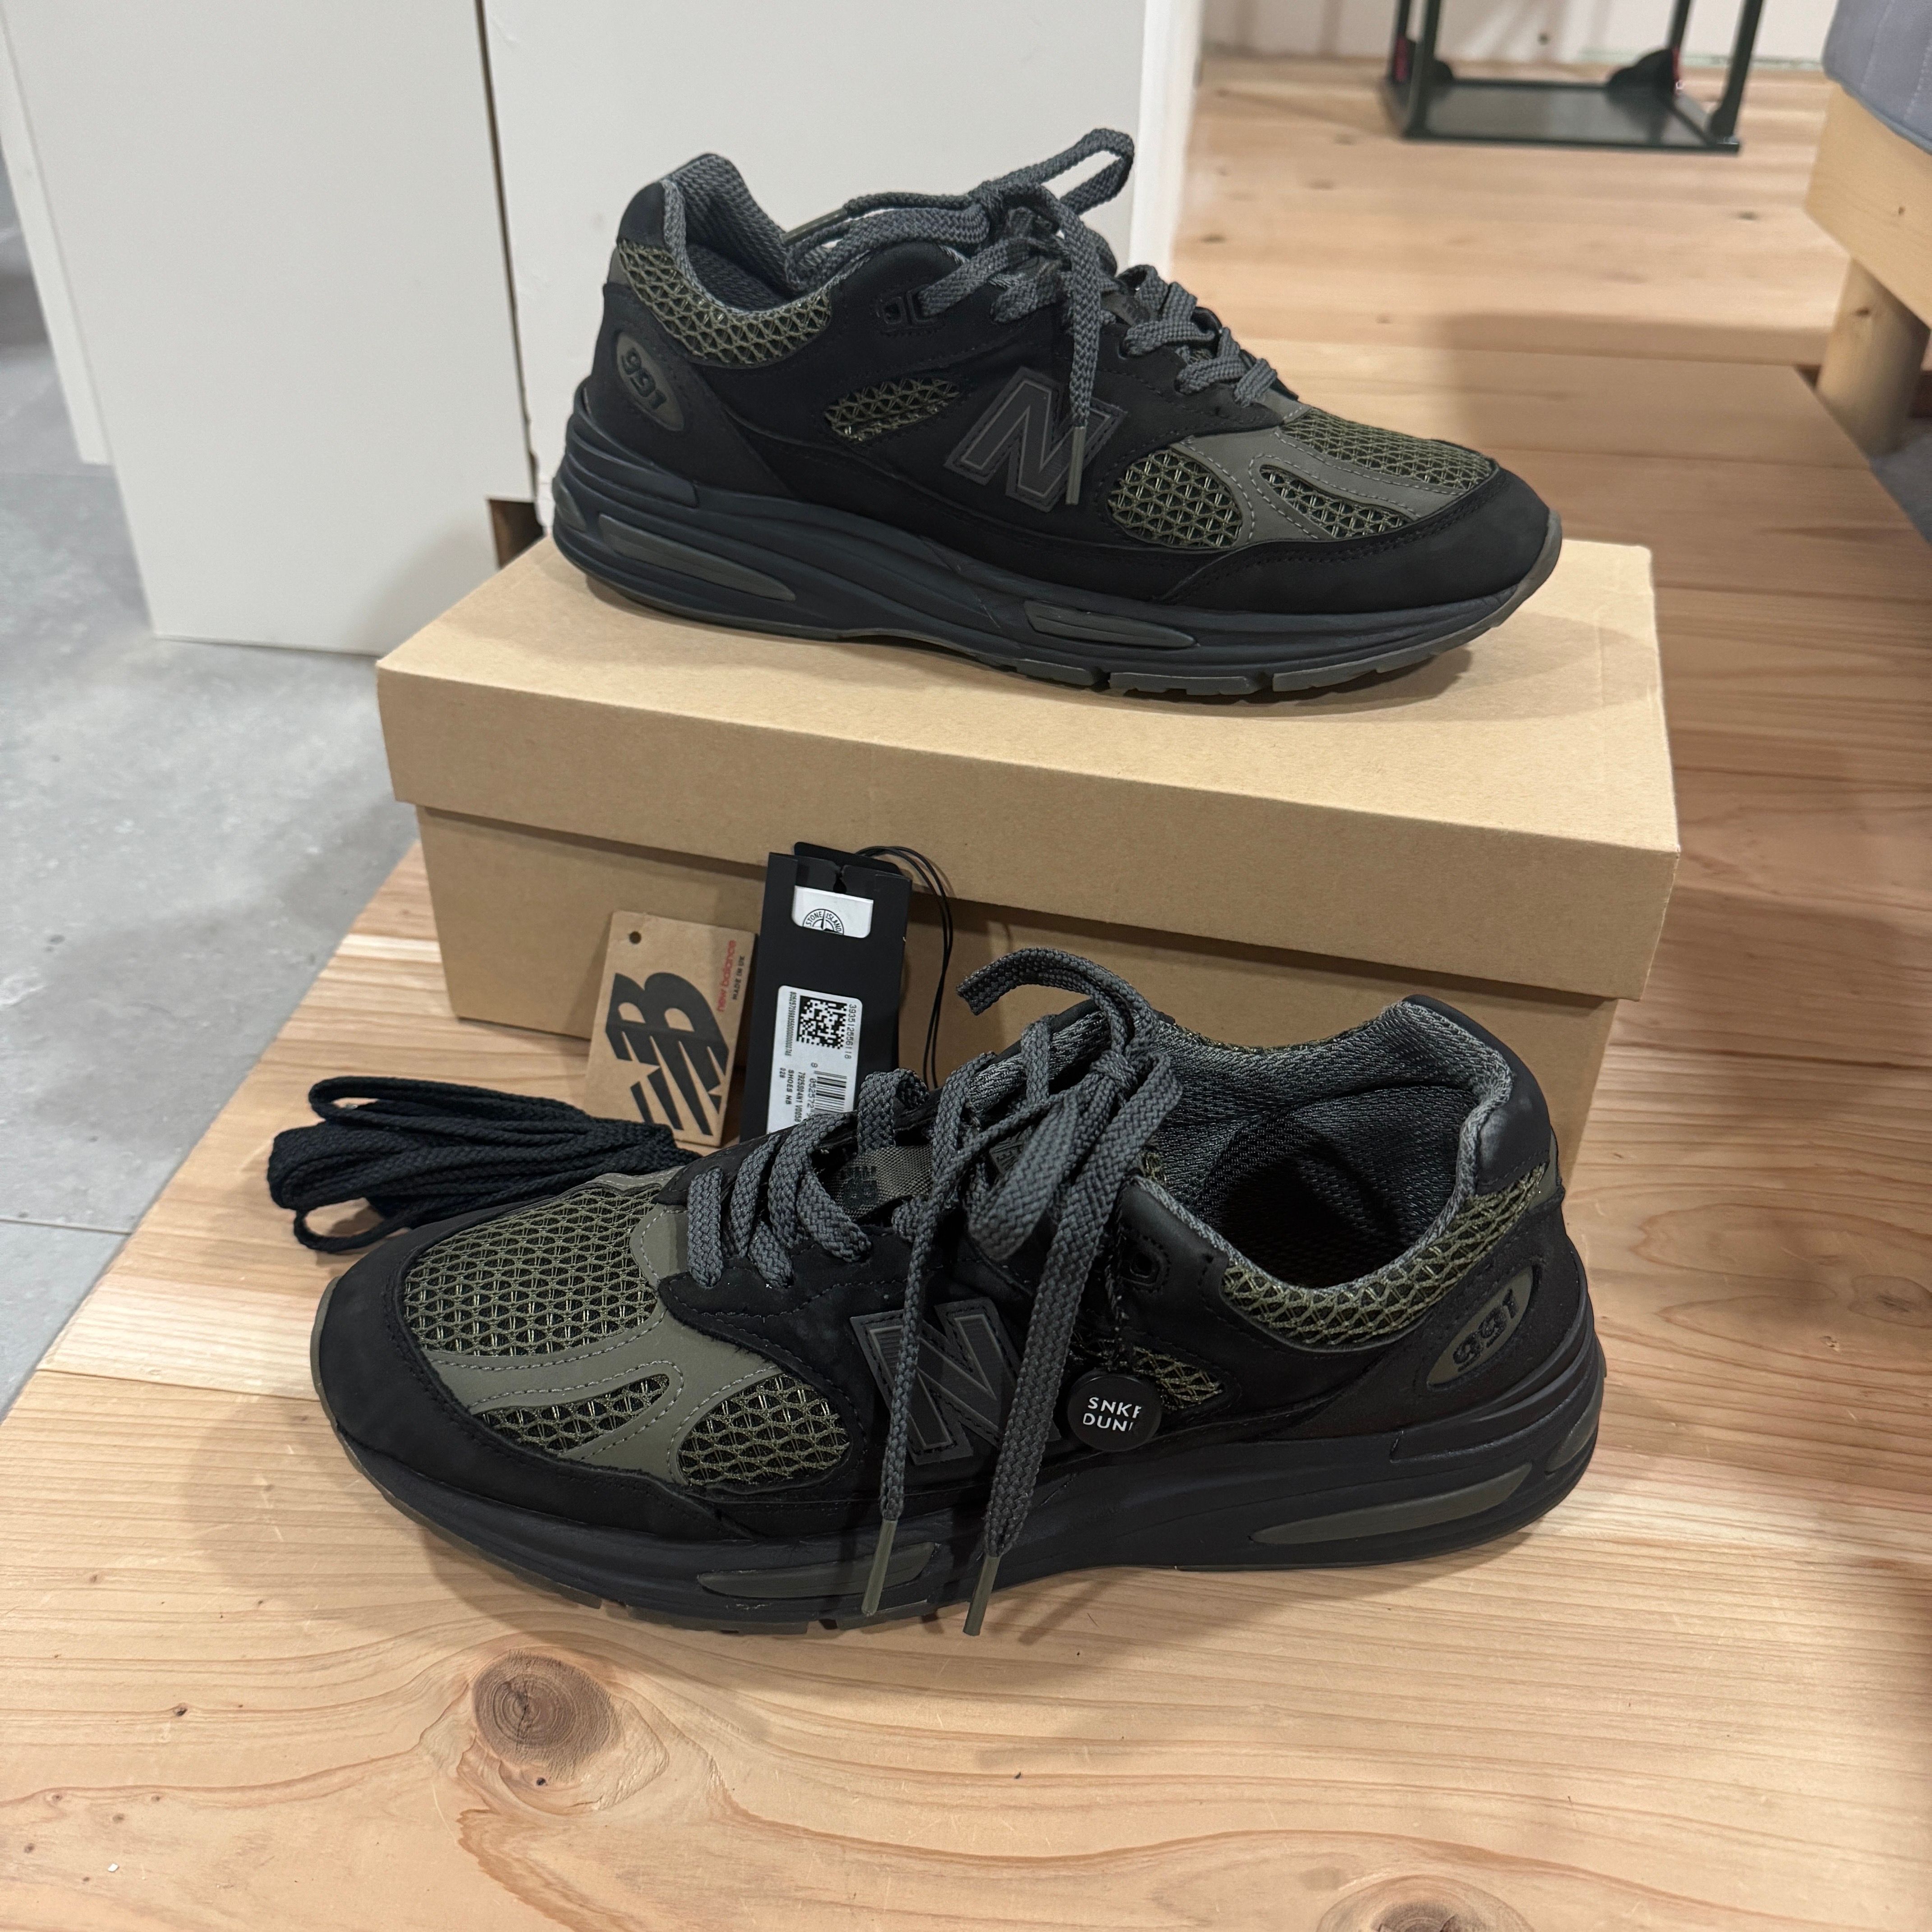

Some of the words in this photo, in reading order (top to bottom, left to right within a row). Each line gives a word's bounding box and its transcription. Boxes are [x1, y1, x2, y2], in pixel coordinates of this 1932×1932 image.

[621, 347, 667, 410] 991
[805, 911, 823, 926] STONE
[826, 912, 842, 932] ISLAND
[720, 939, 736, 987] balance
[736, 967, 743, 977] IN
[738, 955, 745, 966] UK
[716, 989, 727, 1012] new
[732, 978, 741, 1000] MADE
[844, 1004, 857, 1059] 393512556118
[787, 1069, 795, 1092] SHOES
[786, 1095, 792, 1104] NB
[1453, 1288, 1520, 1372] 991
